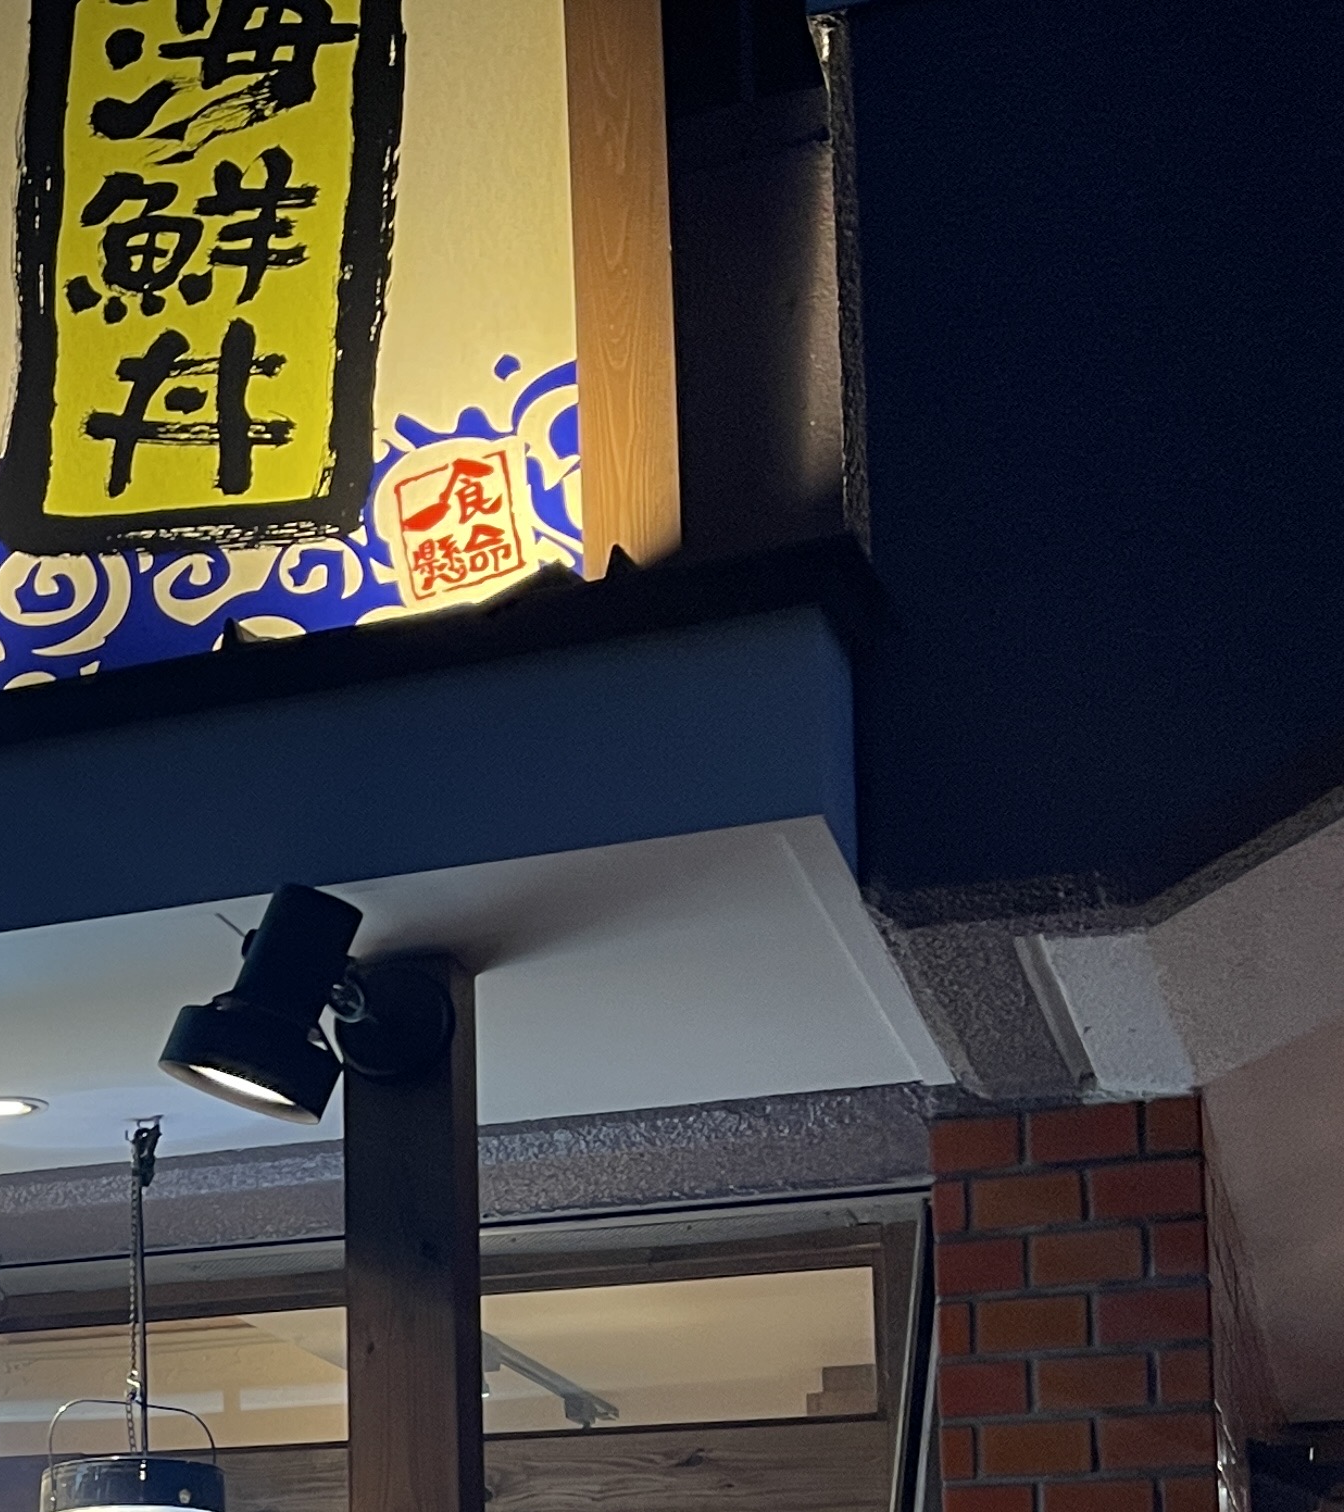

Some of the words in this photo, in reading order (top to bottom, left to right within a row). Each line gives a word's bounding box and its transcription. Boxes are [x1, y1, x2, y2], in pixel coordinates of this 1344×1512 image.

[66, 0, 358, 499] 海鮮丼
[403, 458, 503, 531] 一食
[412, 524, 512, 590] 懸命
